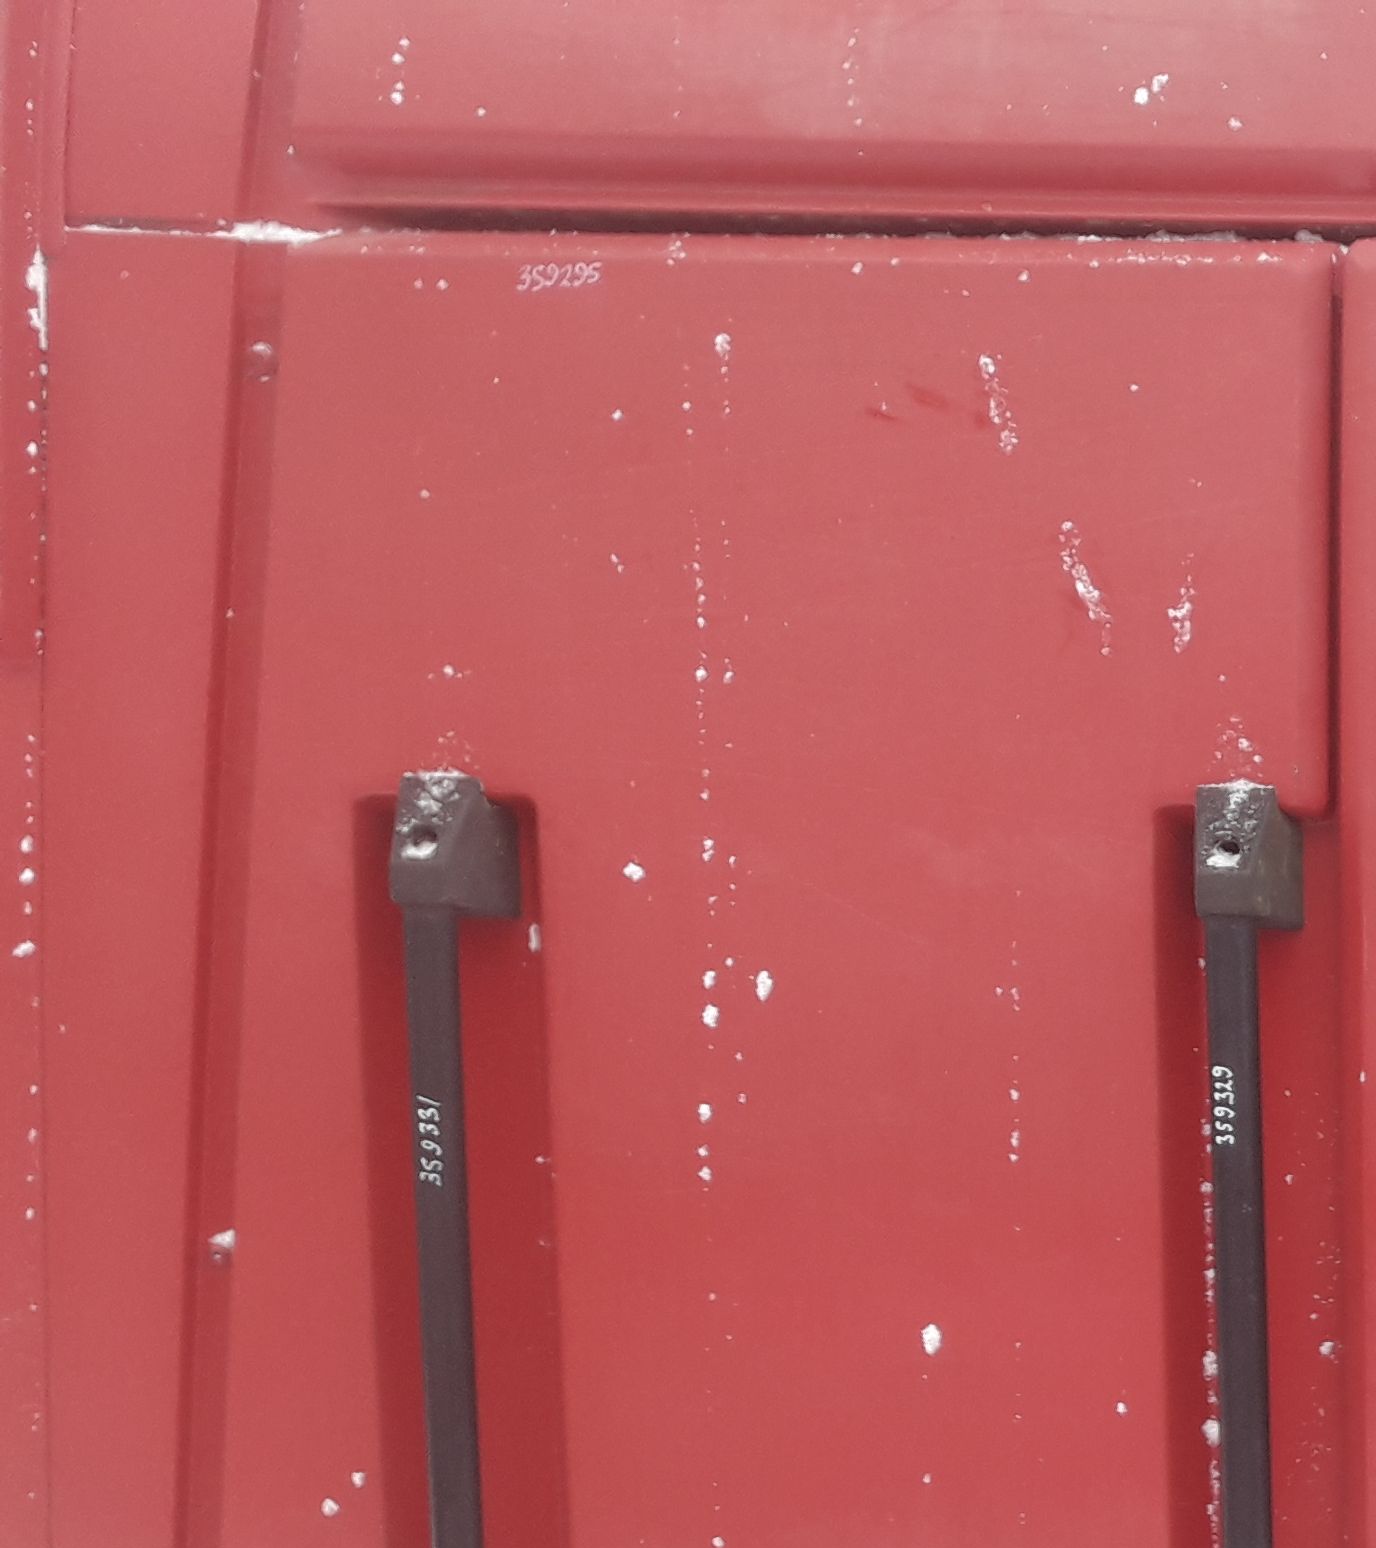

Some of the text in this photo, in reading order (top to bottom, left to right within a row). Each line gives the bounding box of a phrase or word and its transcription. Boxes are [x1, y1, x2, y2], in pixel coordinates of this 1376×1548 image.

[516, 262, 602, 291] 359295
[416, 1094, 443, 1187] 359331
[1211, 1065, 1236, 1145] 359329
